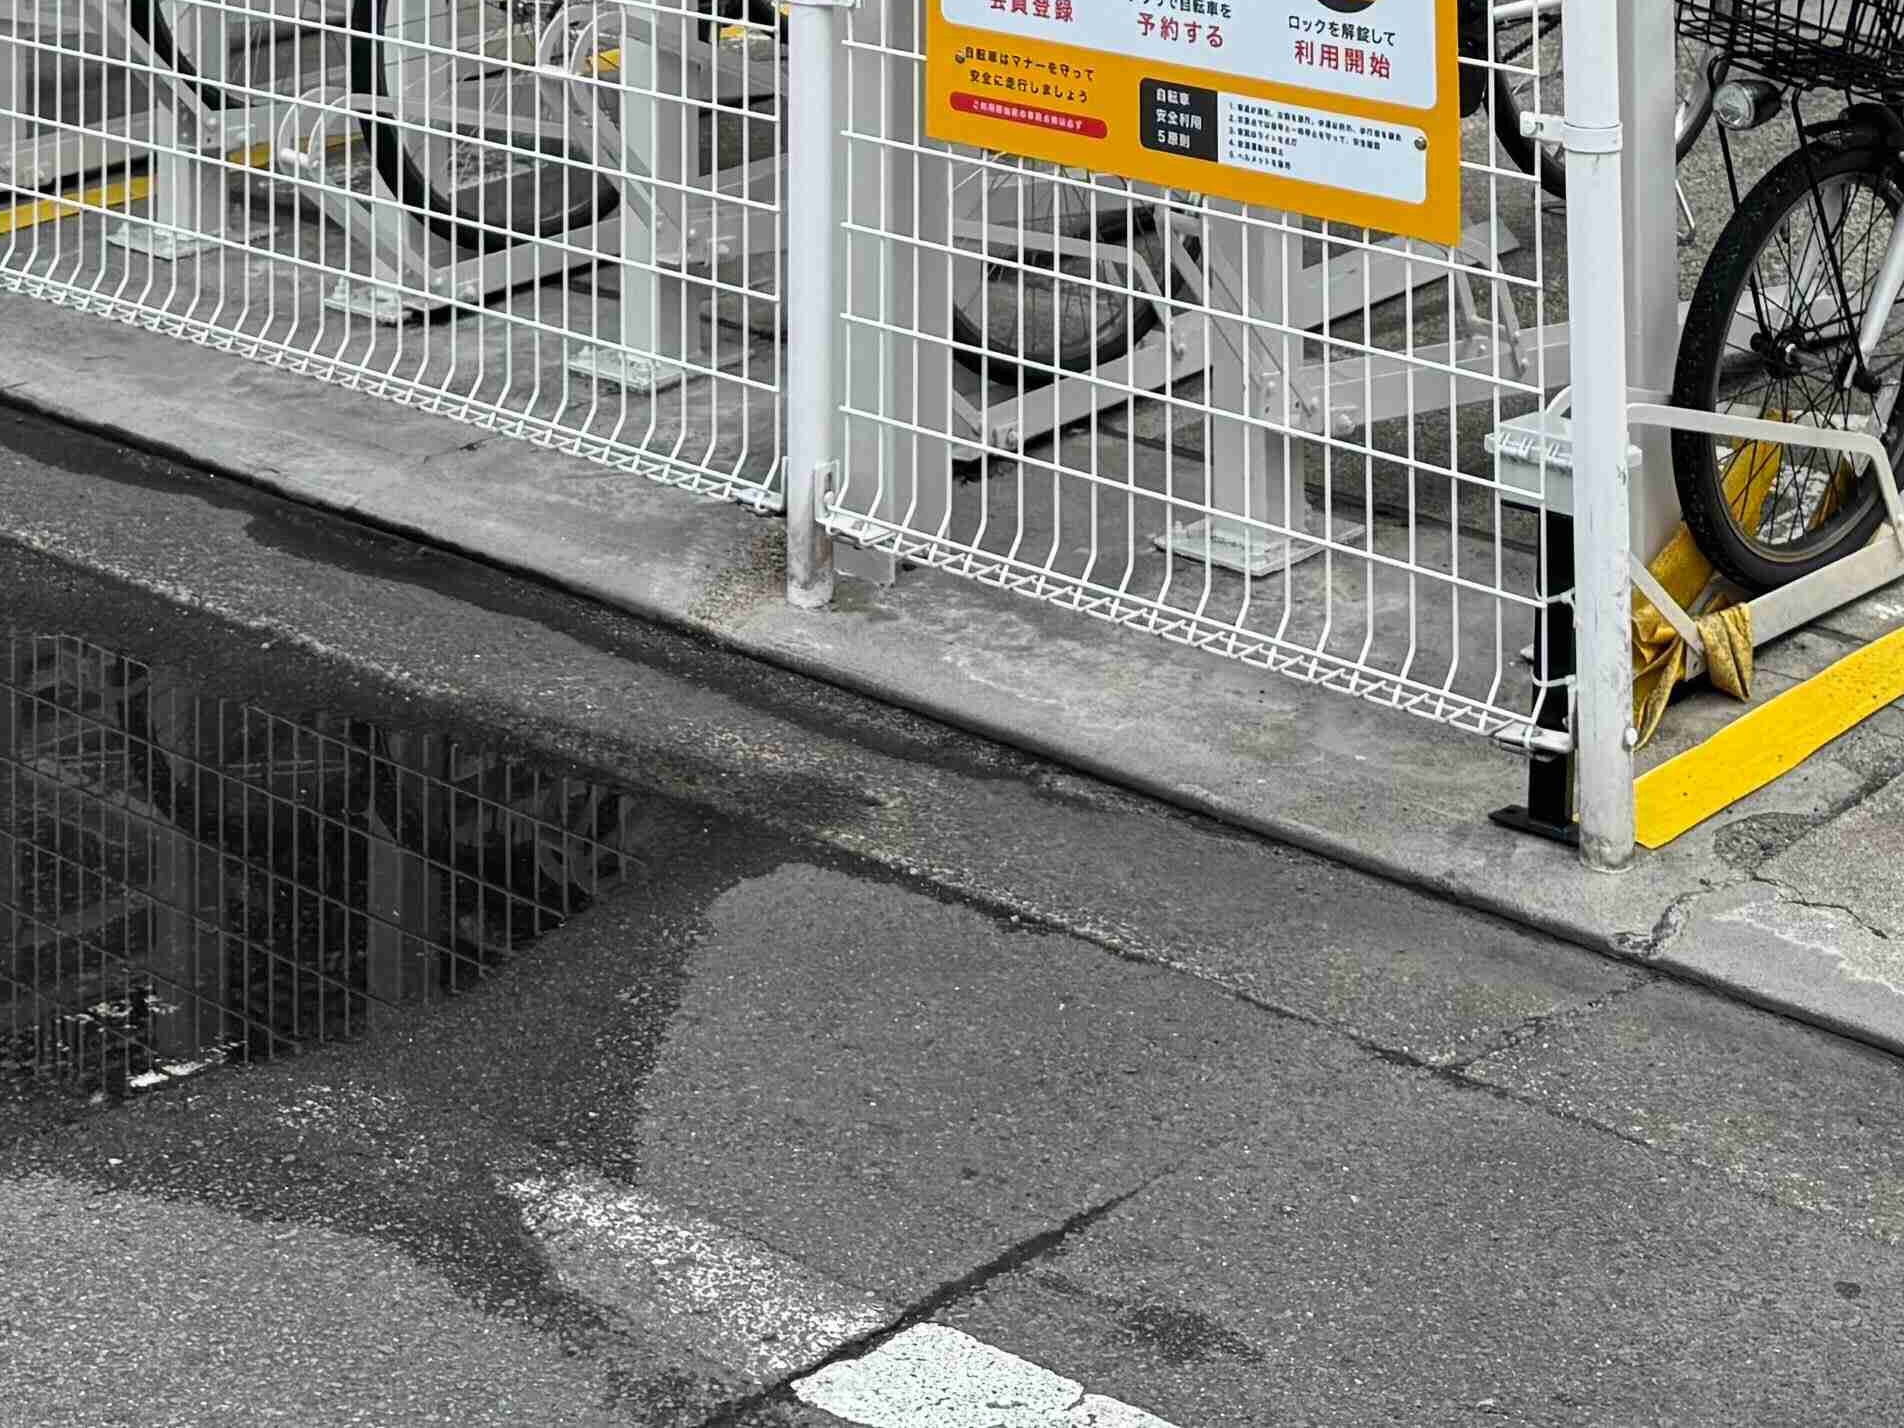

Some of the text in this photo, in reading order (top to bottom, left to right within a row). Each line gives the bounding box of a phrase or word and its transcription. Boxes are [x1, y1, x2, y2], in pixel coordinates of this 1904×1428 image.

[1136, 11, 1225, 48] 予約する
[1287, 15, 1397, 47] ロックを解錠して
[1294, 39, 1391, 79] 利用開始
